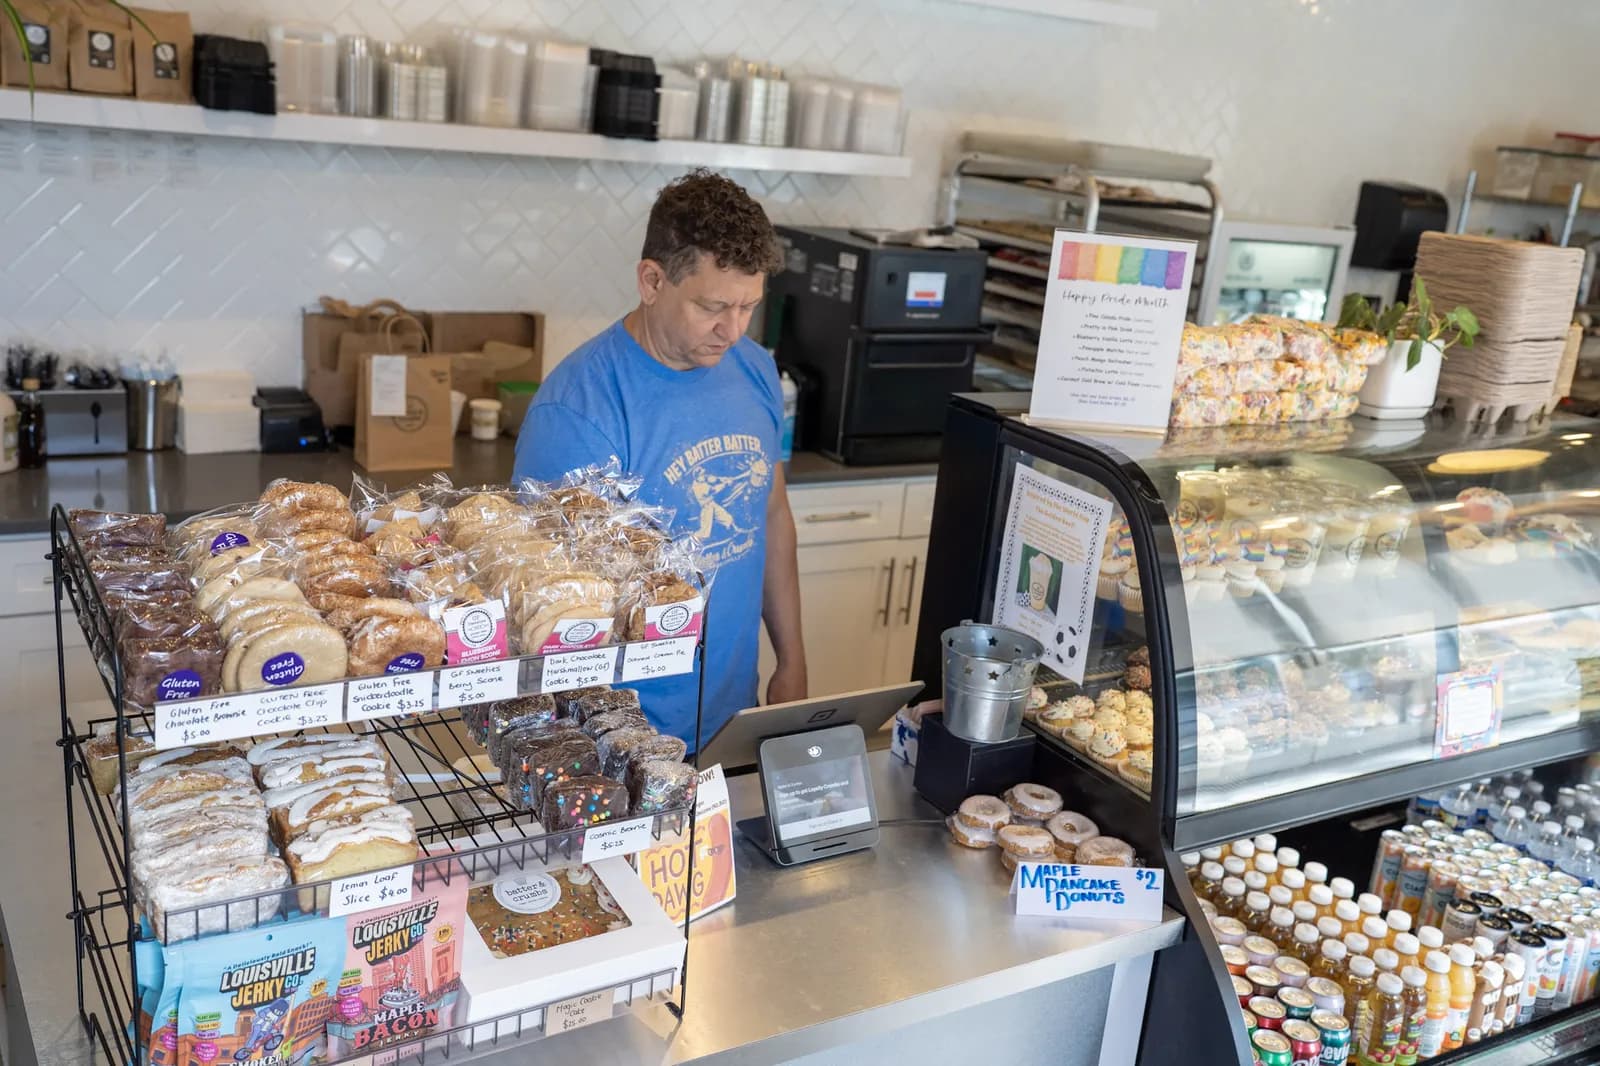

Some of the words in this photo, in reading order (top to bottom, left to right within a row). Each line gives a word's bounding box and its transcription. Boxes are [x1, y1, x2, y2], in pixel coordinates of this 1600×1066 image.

[1062, 290, 1096, 305] Happy
[1101, 293, 1130, 306] Pride
[663, 456, 687, 485] HEY
[684, 437, 723, 466] BATTER
[723, 434, 762, 452] BATTER
[461, 644, 497, 657] BLUEBERRY
[270, 657, 295, 671] Free
[550, 657, 568, 665] Dark
[265, 665, 304, 681] Gluten
[466, 666, 500, 676] Sweeties
[546, 666, 593, 676] Marshmallow
[161, 678, 200, 688] Gluten
[358, 681, 388, 691] Gluten
[393, 676, 411, 687] Free
[448, 682, 473, 691] Berry
[476, 676, 504, 684] Scone
[545, 678, 570, 688] Cookie
[165, 690, 190, 699] Free
[170, 706, 202, 718] Gluten
[210, 701, 230, 710] Free
[305, 699, 327, 708] Chip
[361, 703, 391, 712] Cookie
[165, 715, 209, 730] Chocolate
[214, 710, 246, 722] Brownie
[698, 769, 715, 785] OW!
[590, 830, 616, 840] Cosmic
[650, 838, 703, 889] HOT
[340, 880, 368, 892] Lemon
[374, 872, 398, 884] Loaf
[1021, 864, 1081, 889] MAPLE
[1136, 869, 1160, 890] $2
[504, 884, 538, 896] batter
[512, 889, 548, 902] crumbs
[1045, 878, 1122, 903] PANCAKE
[342, 894, 370, 906] Slice
[1056, 892, 1125, 911] DONUTS
[354, 901, 438, 946] LOUISVILLE
[366, 927, 410, 962] JERKY
[272, 950, 286, 958] Bold
[220, 947, 316, 991] LOUISVILLE
[232, 977, 285, 1008] JERKY
[374, 1002, 425, 1024] MAPLE
[556, 1002, 578, 1015] Magic
[570, 1008, 584, 1016] Cake
[354, 1009, 439, 1048] BACON
[380, 1031, 419, 1047] JERKY
